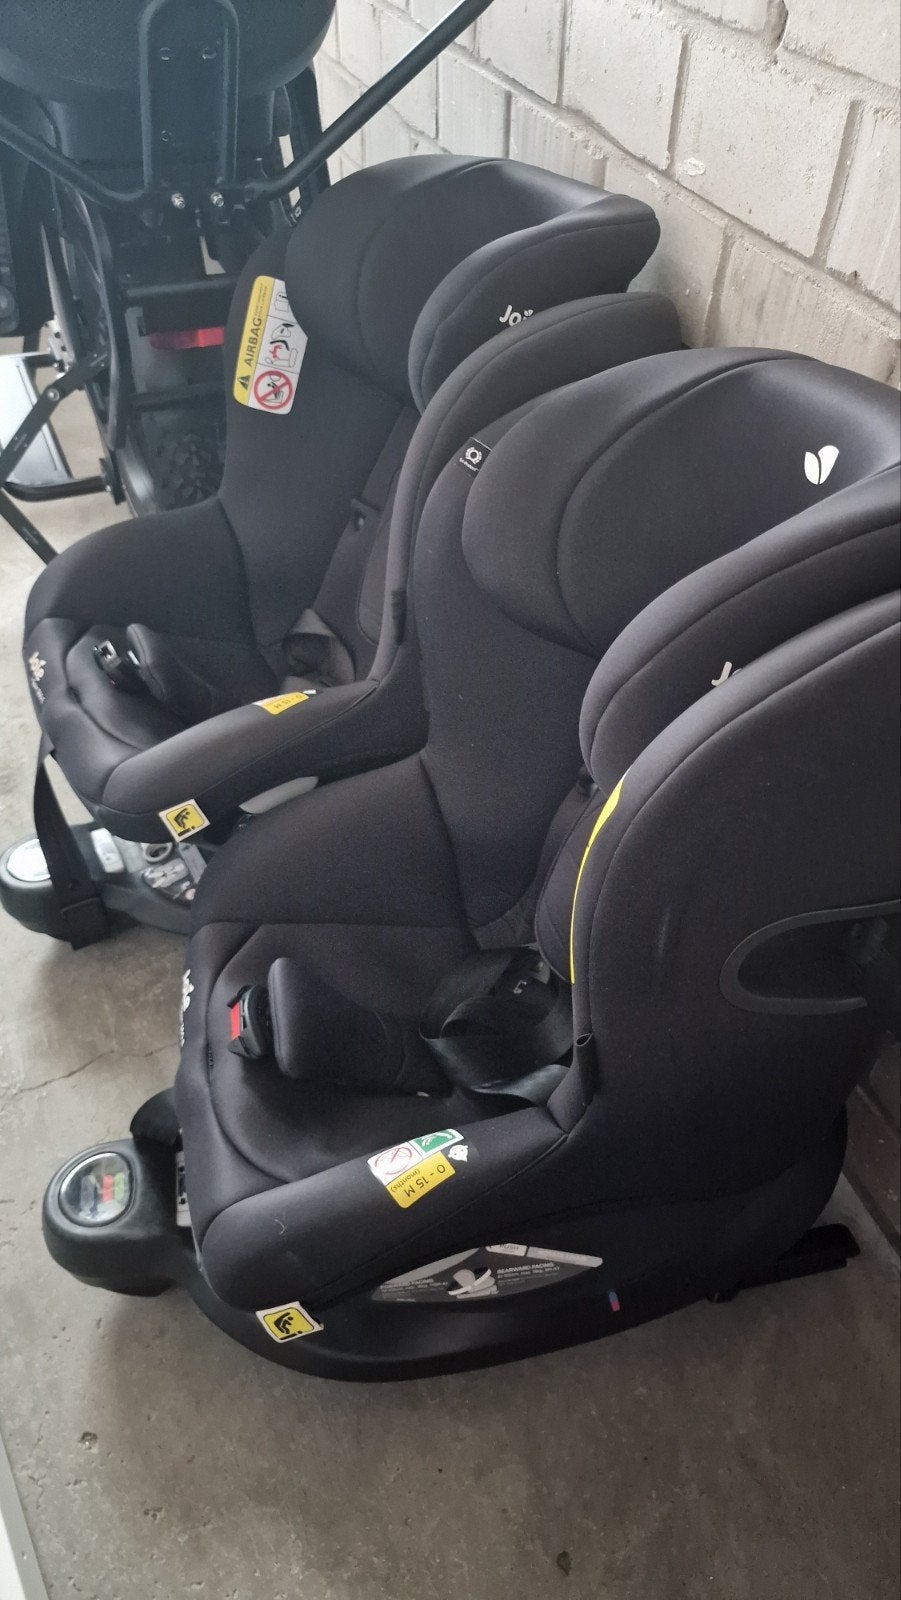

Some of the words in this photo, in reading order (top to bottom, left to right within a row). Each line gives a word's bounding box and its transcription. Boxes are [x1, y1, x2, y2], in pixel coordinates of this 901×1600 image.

[244, 317, 263, 367] AIRBAG
[390, 1168, 421, 1193] (months)
[415, 1176, 430, 1189] 15
[404, 1185, 416, 1198] M
